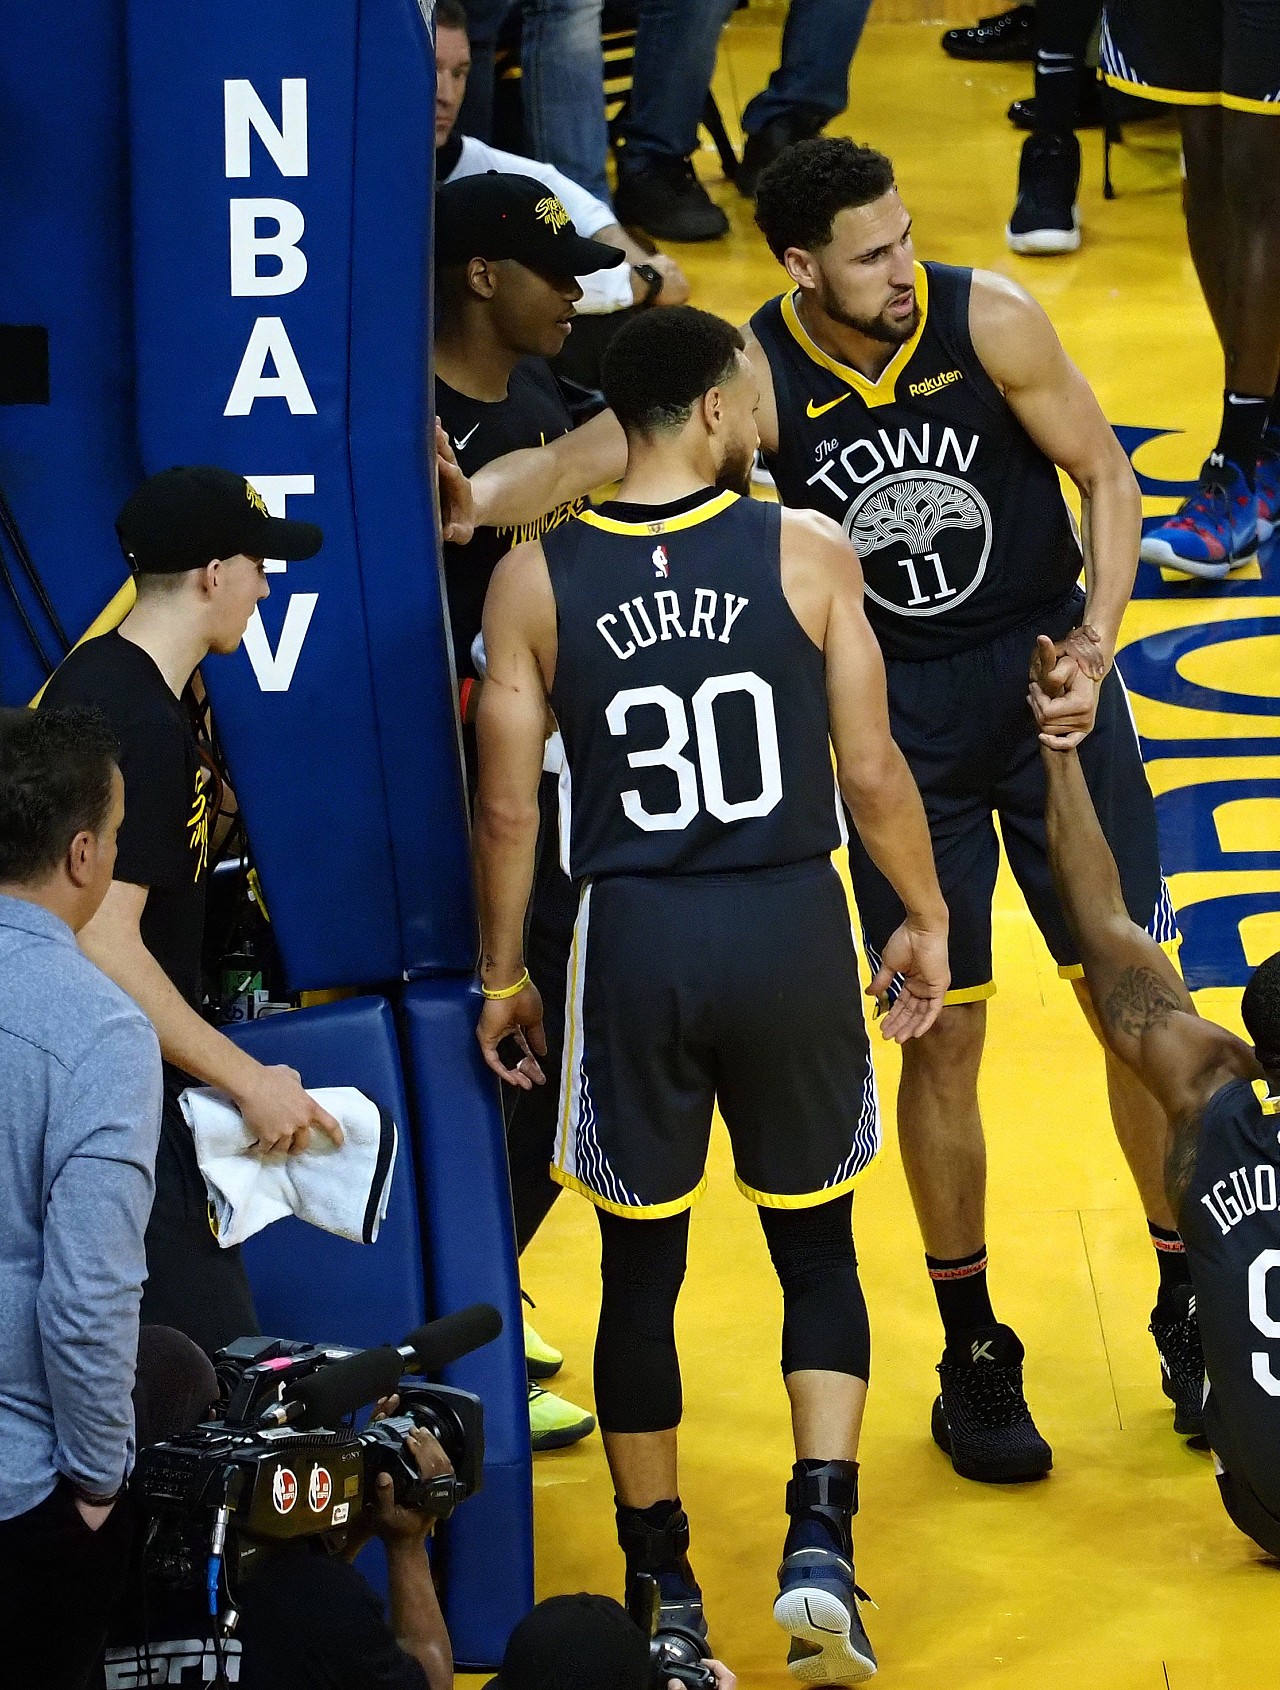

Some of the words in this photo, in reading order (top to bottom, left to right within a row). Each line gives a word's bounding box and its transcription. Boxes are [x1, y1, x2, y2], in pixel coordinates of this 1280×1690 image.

[223, 78, 318, 416] NBA
[909, 369, 964, 397] Rakuten
[806, 422, 980, 502] TOWN
[814, 437, 840, 462] The
[242, 474, 320, 692] TV
[898, 552, 957, 606] 11
[596, 587, 750, 660] CURRY
[604, 671, 784, 832] 30
[341, 1450, 361, 1462] SONY
[104, 1638, 243, 1690] ESPN
